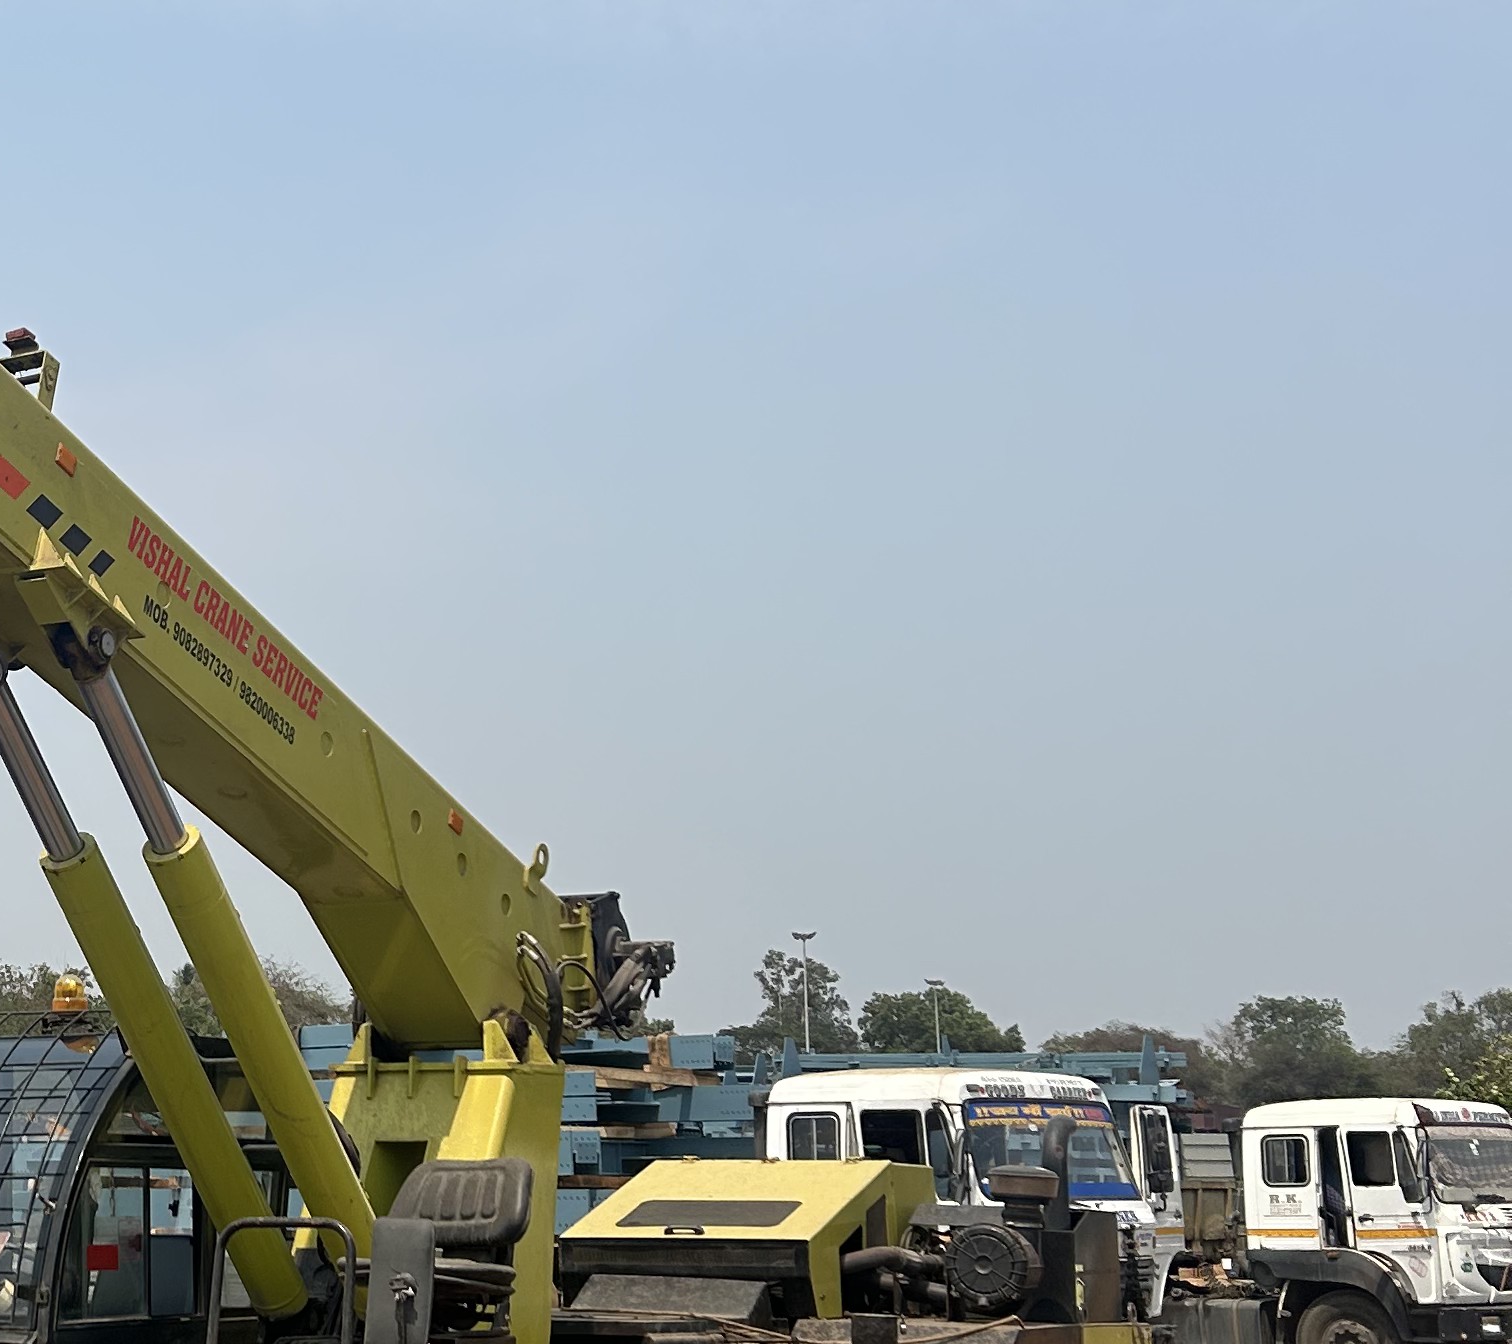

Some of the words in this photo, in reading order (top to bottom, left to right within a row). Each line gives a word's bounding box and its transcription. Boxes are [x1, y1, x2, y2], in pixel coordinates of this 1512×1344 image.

[127, 515, 191, 602] VISHAL
[193, 579, 254, 655] CRANE
[251, 635, 324, 720] SERVICE
[143, 594, 170, 634] MOB.
[239, 680, 296, 745] 9820006338
[985, 1084, 1026, 1098] GOODS
